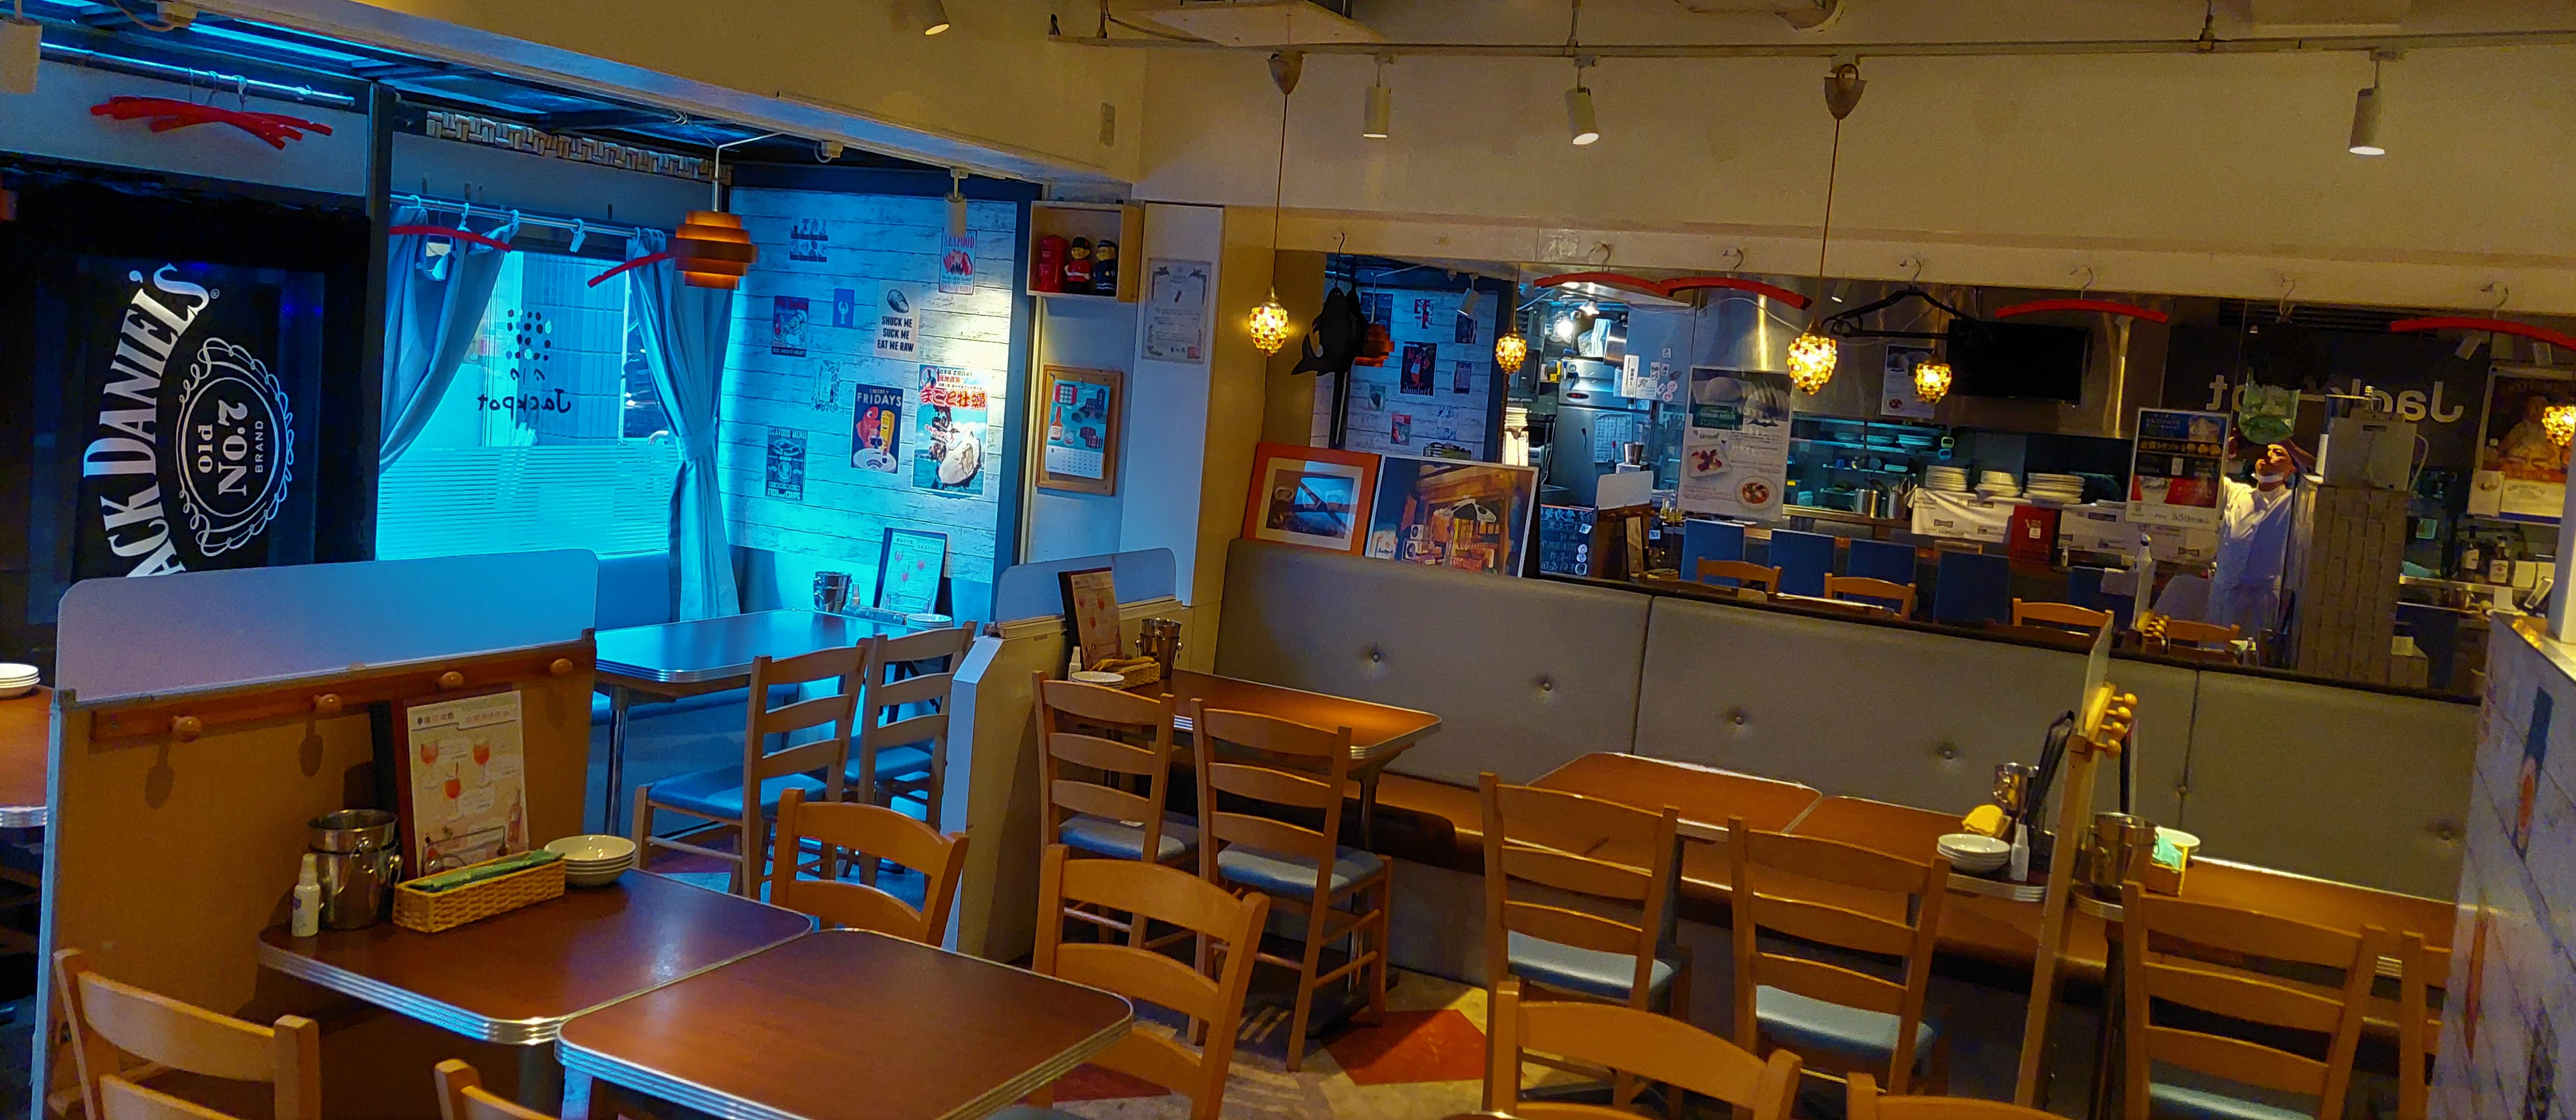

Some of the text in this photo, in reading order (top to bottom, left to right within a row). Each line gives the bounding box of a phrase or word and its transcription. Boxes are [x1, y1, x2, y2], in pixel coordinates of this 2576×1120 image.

[881, 315, 913, 328] SHUCK ME
[882, 328, 910, 340] SUCK ME
[877, 339, 914, 352] EAT ME RAW
[857, 392, 901, 407] FRIDAYS
[769, 427, 791, 437] SEAFOOD
[255, 420, 264, 473] BRAND
[100, 481, 186, 578] ACK
